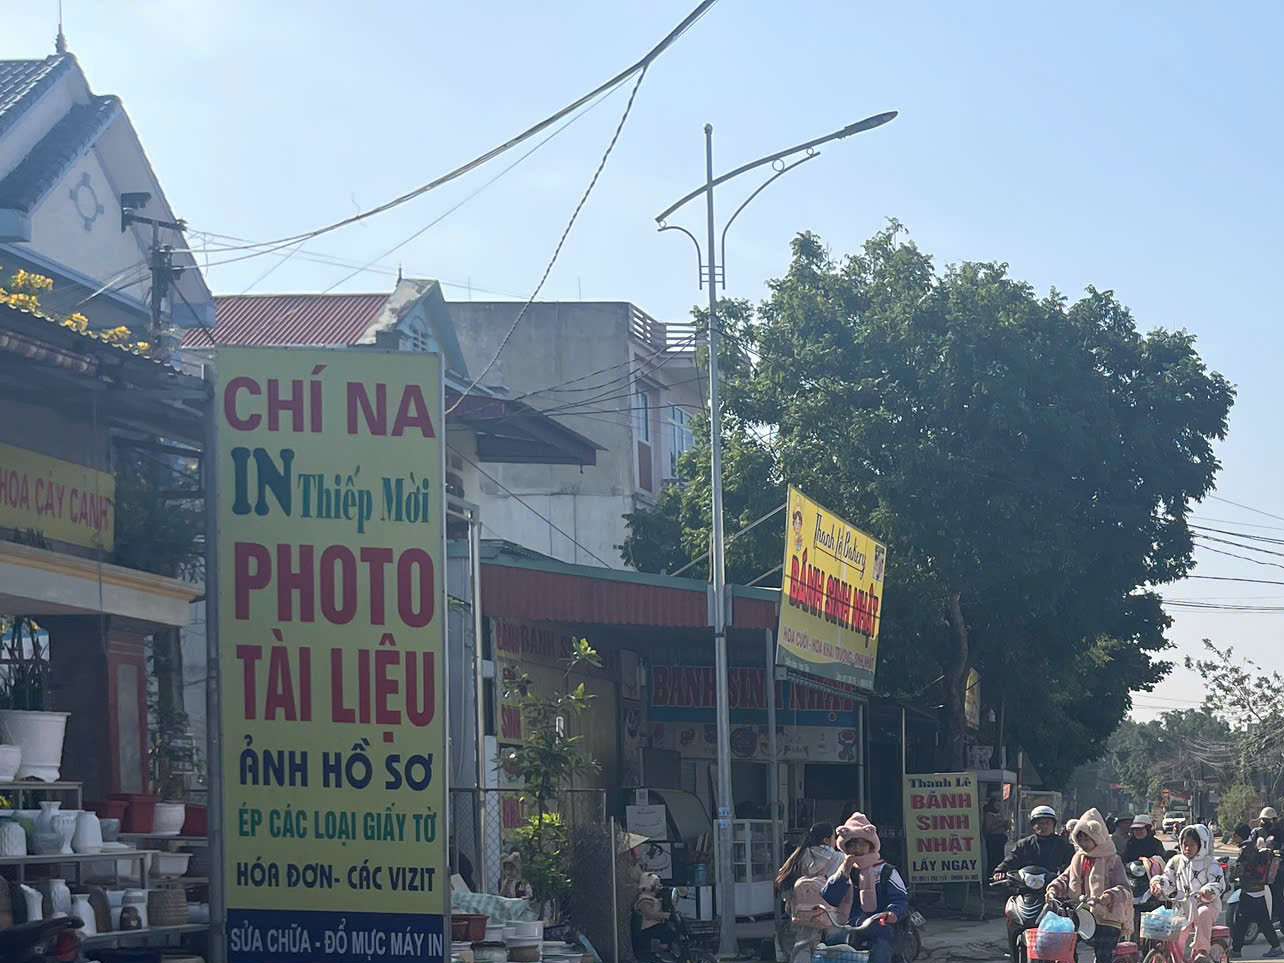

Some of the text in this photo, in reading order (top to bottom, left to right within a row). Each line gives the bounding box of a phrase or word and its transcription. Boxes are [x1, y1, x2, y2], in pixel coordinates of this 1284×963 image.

[224, 364, 436, 438] CHÍ NA
[230, 446, 430, 534] IN Thiếp Mời
[814, 512, 836, 549] Thanh
[234, 541, 434, 628] PHOTO
[789, 547, 879, 648] BÁNH SINH NHẬT
[236, 628, 435, 743] TÀI LIỆU
[239, 734, 433, 791] ẢNH HỒ SƠ
[908, 777, 972, 788] Thanh Lê
[911, 791, 972, 809] BÁNH
[239, 802, 437, 846] ÉP CÁC LOẠI GIẤY TỜ
[916, 815, 970, 831] SINH
[912, 857, 977, 872] LẤY NGAY
[917, 834, 974, 855] NHẬT
[237, 856, 280, 888] HÓA
[347, 859, 382, 890] CÁC
[388, 866, 435, 892] VIZIT
[231, 920, 263, 952] SỬA
[267, 924, 312, 953] CHỮA
[324, 918, 347, 954] ĐỔ
[352, 929, 386, 960] MỰC
[391, 926, 424, 957] MÁY
[428, 933, 443, 957] IN
